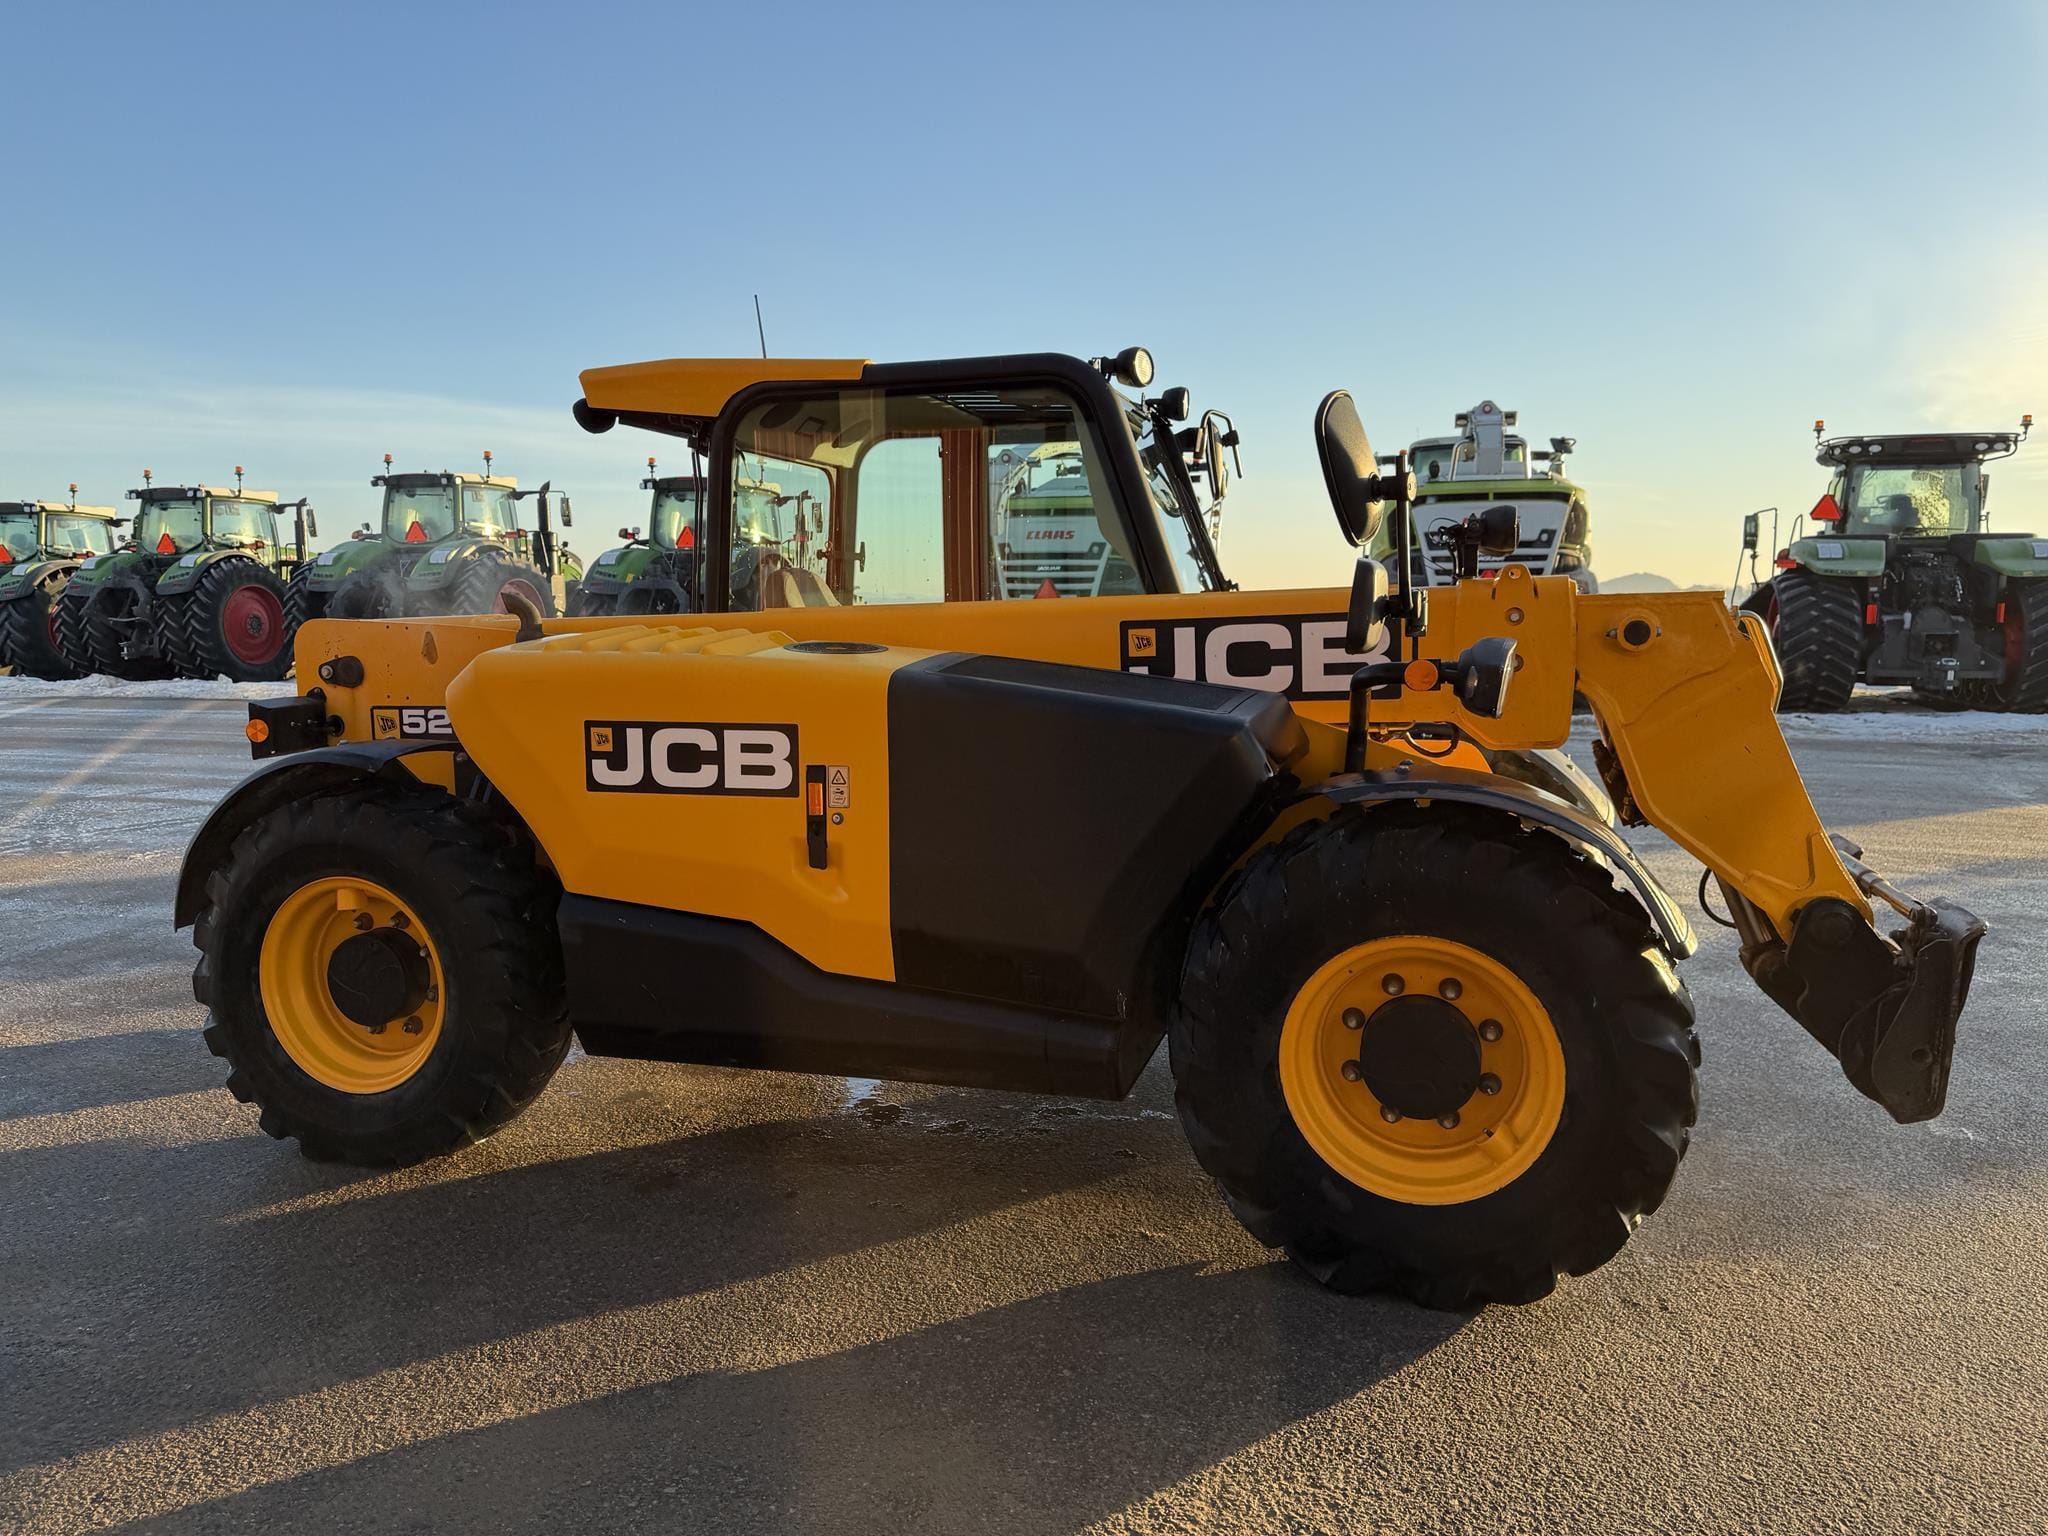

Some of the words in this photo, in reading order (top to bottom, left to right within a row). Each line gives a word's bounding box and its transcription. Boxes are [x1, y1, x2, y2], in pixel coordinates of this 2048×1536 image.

[1026, 530, 1075, 540] CLAAS
[381, 716, 396, 732] JCB
[592, 727, 793, 790] JCB
